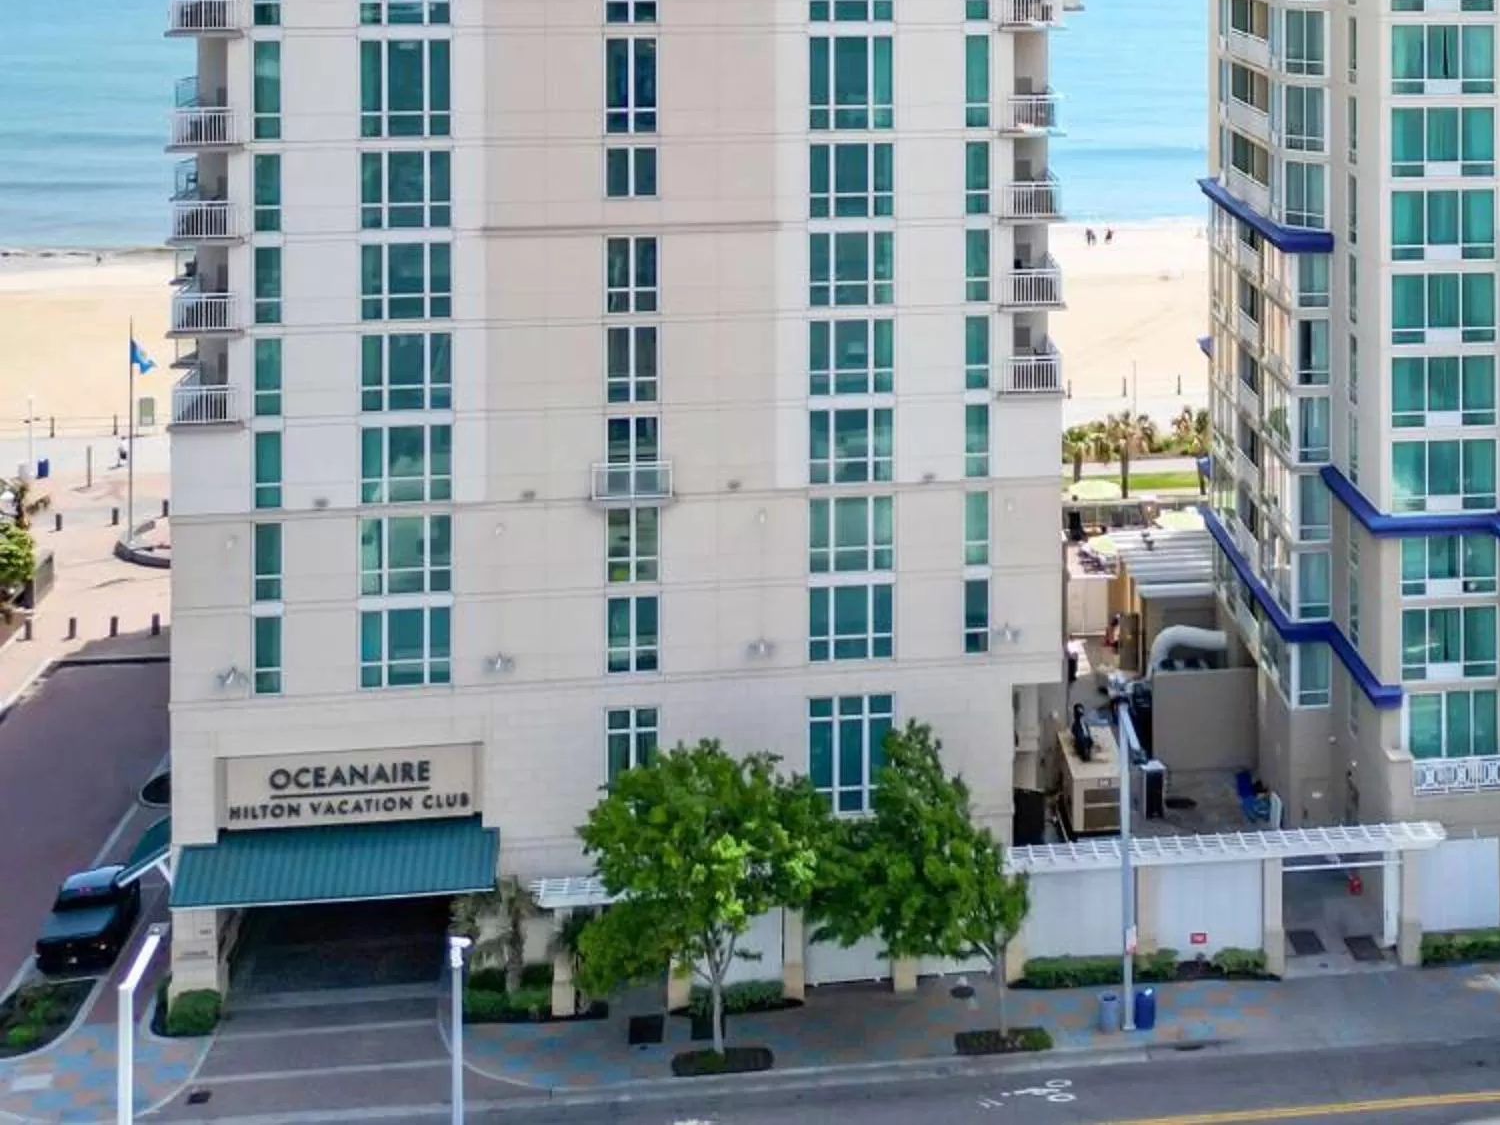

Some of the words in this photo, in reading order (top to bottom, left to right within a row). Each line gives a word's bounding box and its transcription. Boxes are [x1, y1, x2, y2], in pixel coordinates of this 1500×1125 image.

[269, 760, 431, 789] OCEANAIRE
[229, 803, 300, 820] HILTON
[310, 796, 413, 816] VACATION
[422, 792, 470, 810] CLUB
